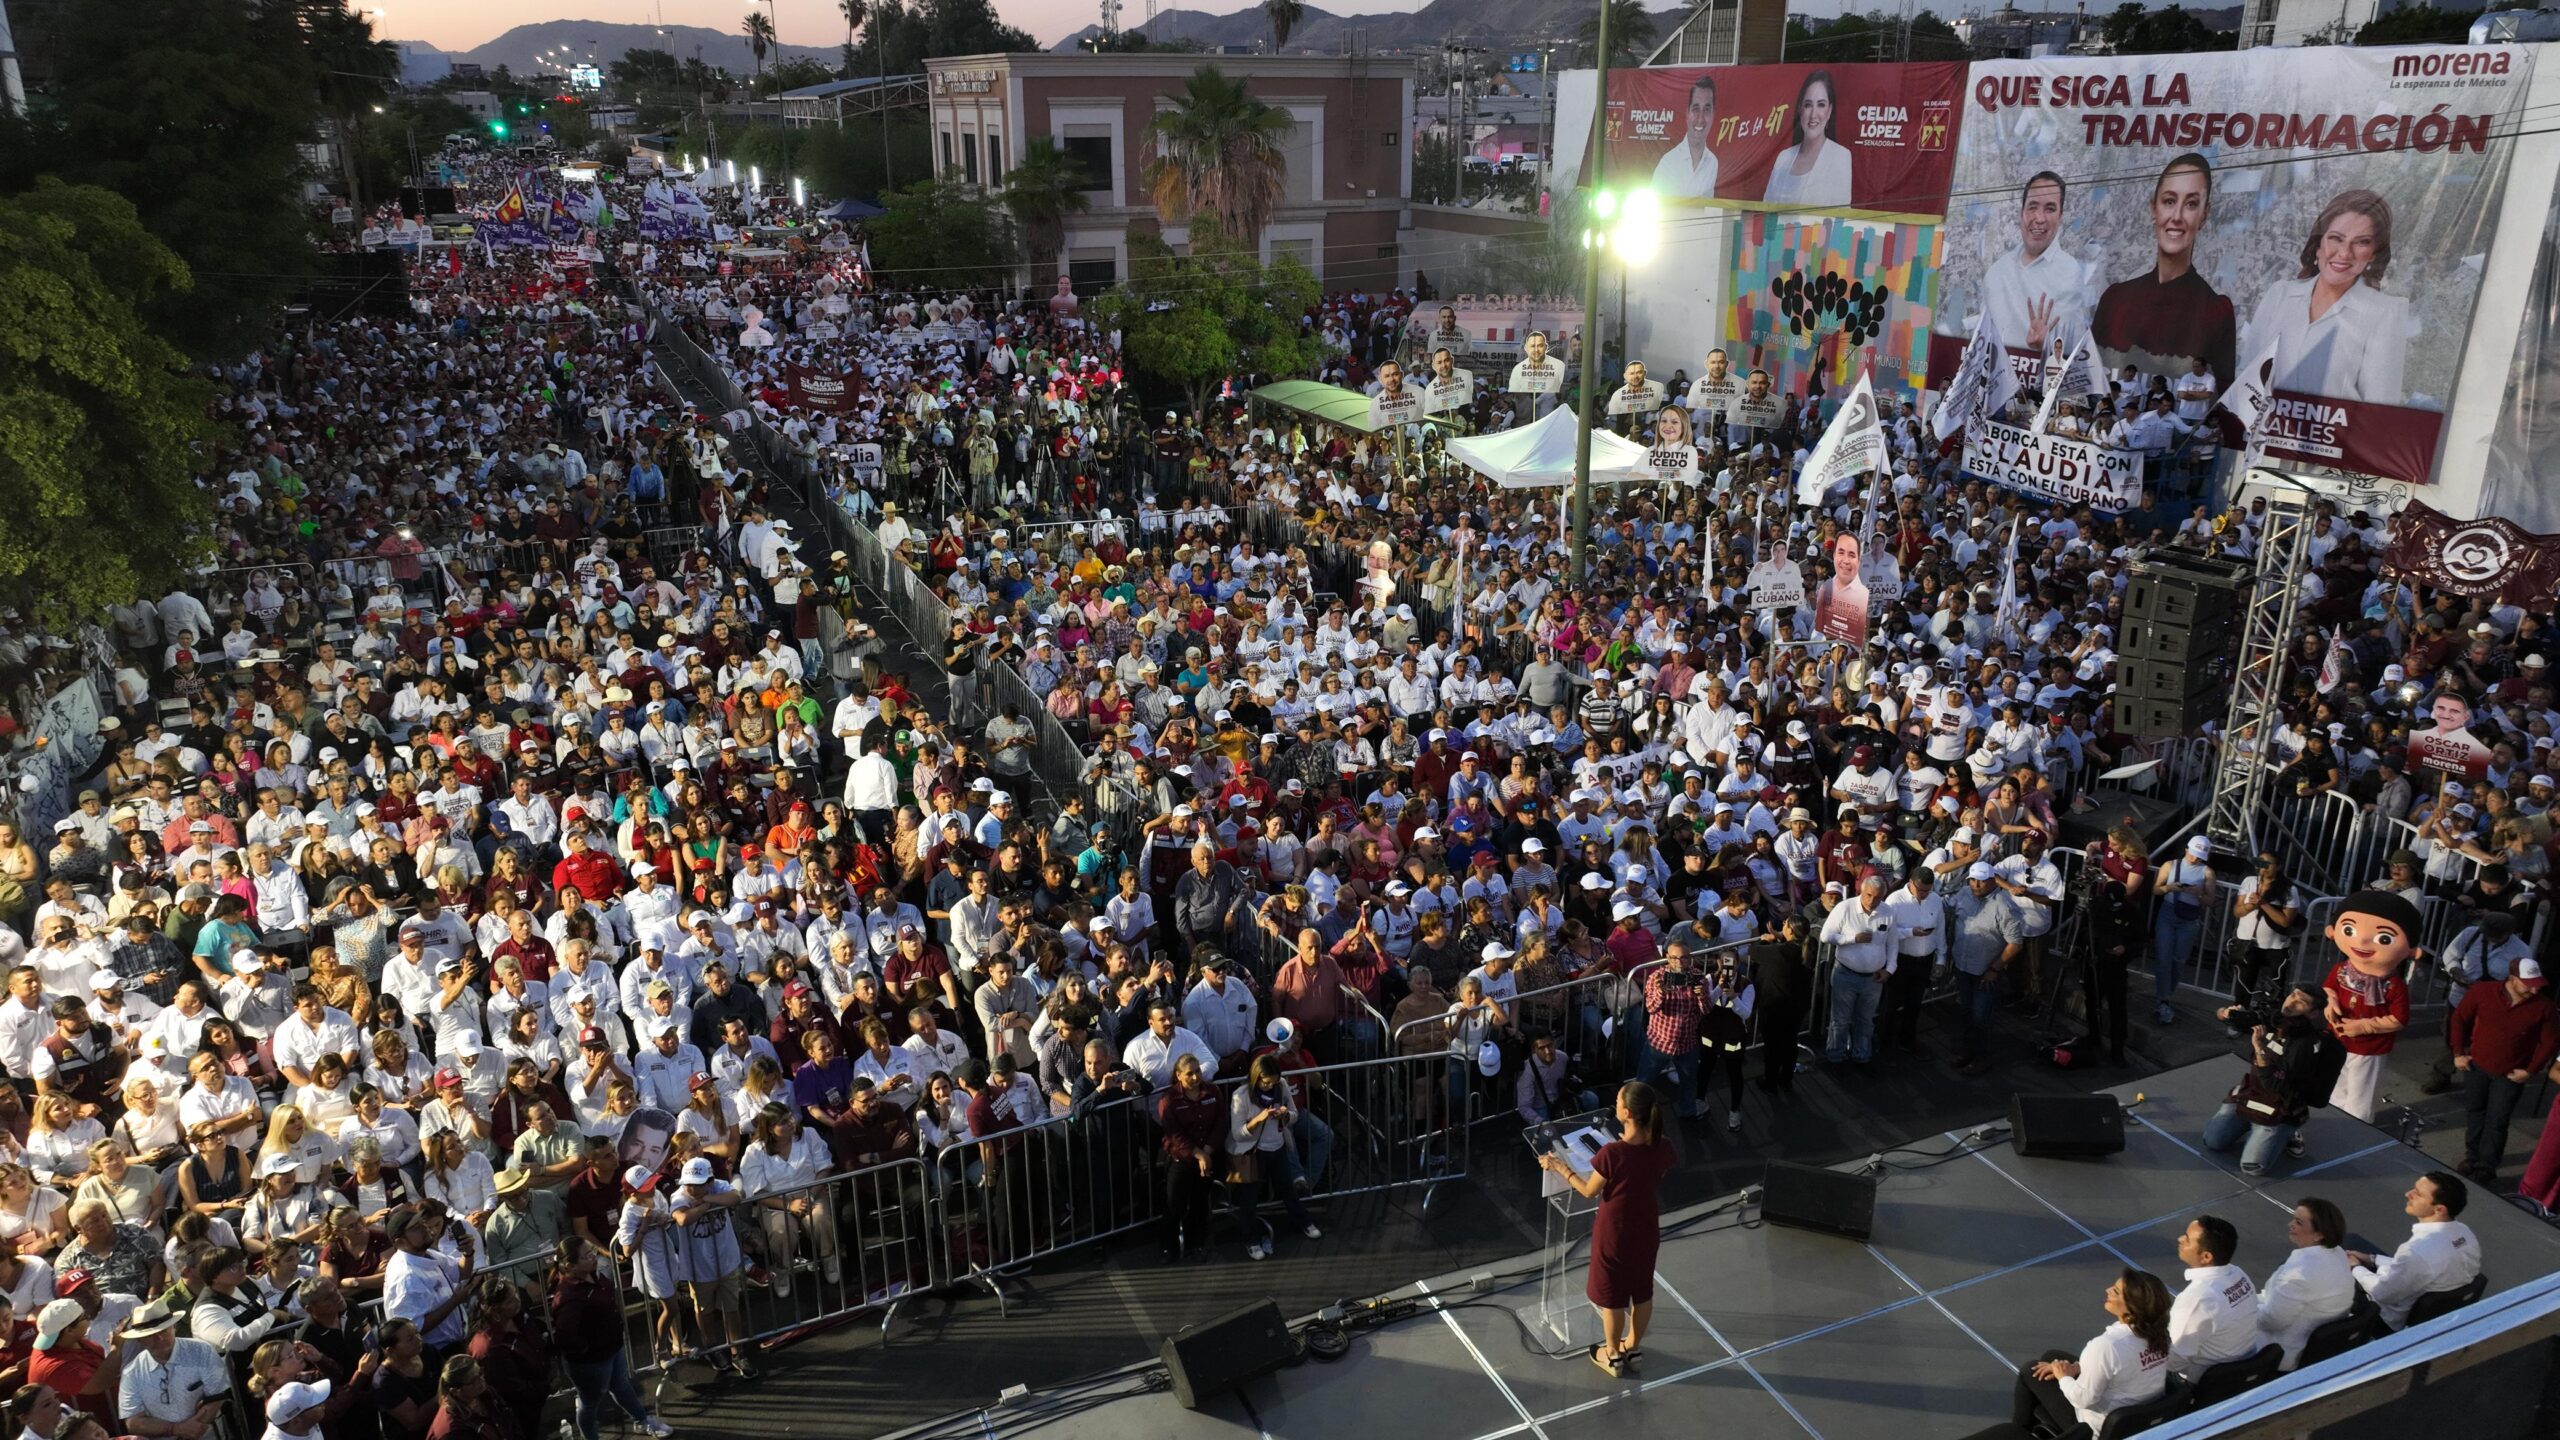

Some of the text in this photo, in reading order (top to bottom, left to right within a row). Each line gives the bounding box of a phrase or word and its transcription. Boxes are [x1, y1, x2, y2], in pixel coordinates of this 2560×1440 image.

[2392, 51, 2511, 77] morena
[2390, 77, 2506, 90] La esperanza de México
[1975, 72, 2192, 113] QUE SIGA LA
[1630, 108, 1674, 123] FROYLÁN
[1857, 105, 1908, 122] CELIDA
[1738, 120, 1750, 138] ES
[1752, 117, 1763, 136] LA
[1765, 104, 1789, 136] 4T
[1636, 122, 1665, 135] GÁMEZ
[1860, 121, 1902, 138] LÓPEZ
[2081, 103, 2494, 155] TRANSFORMACIÓN
[1921, 125, 1946, 147] PT
[1750, 330, 1758, 340] YO
[1762, 332, 1789, 346] TAMBIEN
[1858, 352, 1871, 363] UN
[1874, 354, 1902, 369] MUNDO
[800, 376, 844, 387] CLAUDIA
[800, 383, 845, 393] SHEINBAUM
[1433, 376, 1464, 389] SAMUEL
[1701, 380, 1735, 388] SAMUEL
[1434, 383, 1465, 396] BORBON
[1621, 387, 1654, 396] SAMUEL
[1700, 387, 1735, 395] BORBON
[1379, 392, 1415, 403] SAMUEL
[1621, 393, 1654, 401] BORBON
[1741, 398, 1776, 408] SAMUEL
[1379, 399, 1416, 411] BORBON
[1740, 405, 1776, 414] BORBON
[2267, 417, 2335, 445] ALLES
[1984, 422, 2131, 472] ABORCA ESTÁ CON
[2298, 443, 2334, 454] SENADORA
[1649, 450, 1689, 460] JUDITH
[1648, 459, 1688, 467] ICEDO
[1982, 437, 2114, 492] CLAUDIA
[1969, 456, 2000, 477] ESTÁ
[2007, 469, 2037, 488] CON
[2042, 479, 2058, 494] EL
[2059, 484, 2128, 512] CUBANO
[1869, 587, 1897, 595] BANO
[2454, 577, 2508, 594] CANANEA
[1756, 594, 1800, 603] CUBANO
[251, 606, 282, 617] VICKY
[2425, 736, 2470, 751] OSCAR
[2424, 744, 2469, 759] ORTIZ
[2422, 756, 2466, 772] morena
[1850, 782, 1879, 791] JACOBO
[446, 802, 471, 813] VICKY
[760, 901, 770, 910] m
[901, 924, 913, 934] m
[696, 1072, 710, 1081] m
[68, 1271, 84, 1282] m
[2228, 1284, 2252, 1304] AGUILAR
